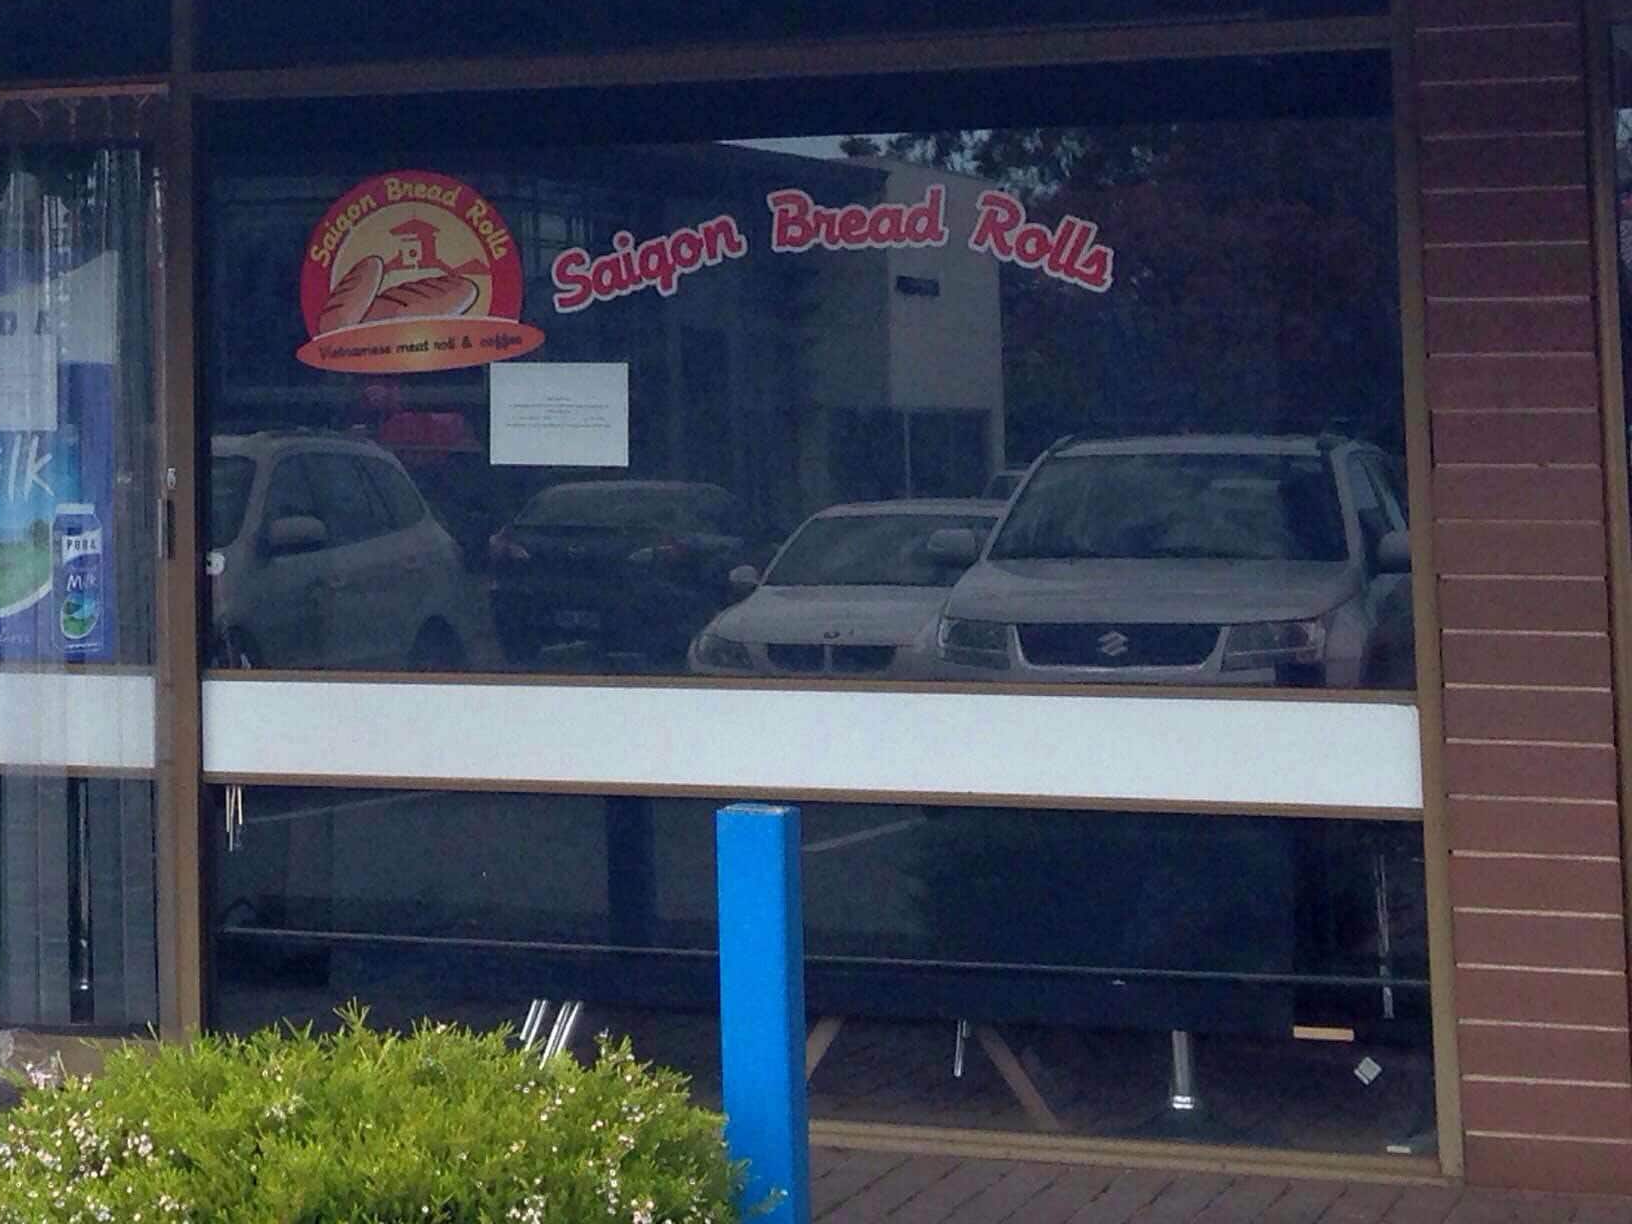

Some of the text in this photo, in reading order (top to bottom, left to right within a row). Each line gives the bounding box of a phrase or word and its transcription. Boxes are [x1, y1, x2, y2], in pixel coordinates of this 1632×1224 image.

[310, 176, 509, 268] Saigon Bread Rolls
[554, 185, 1113, 311] Saigon Bread Rolls
[396, 339, 429, 355] meat
